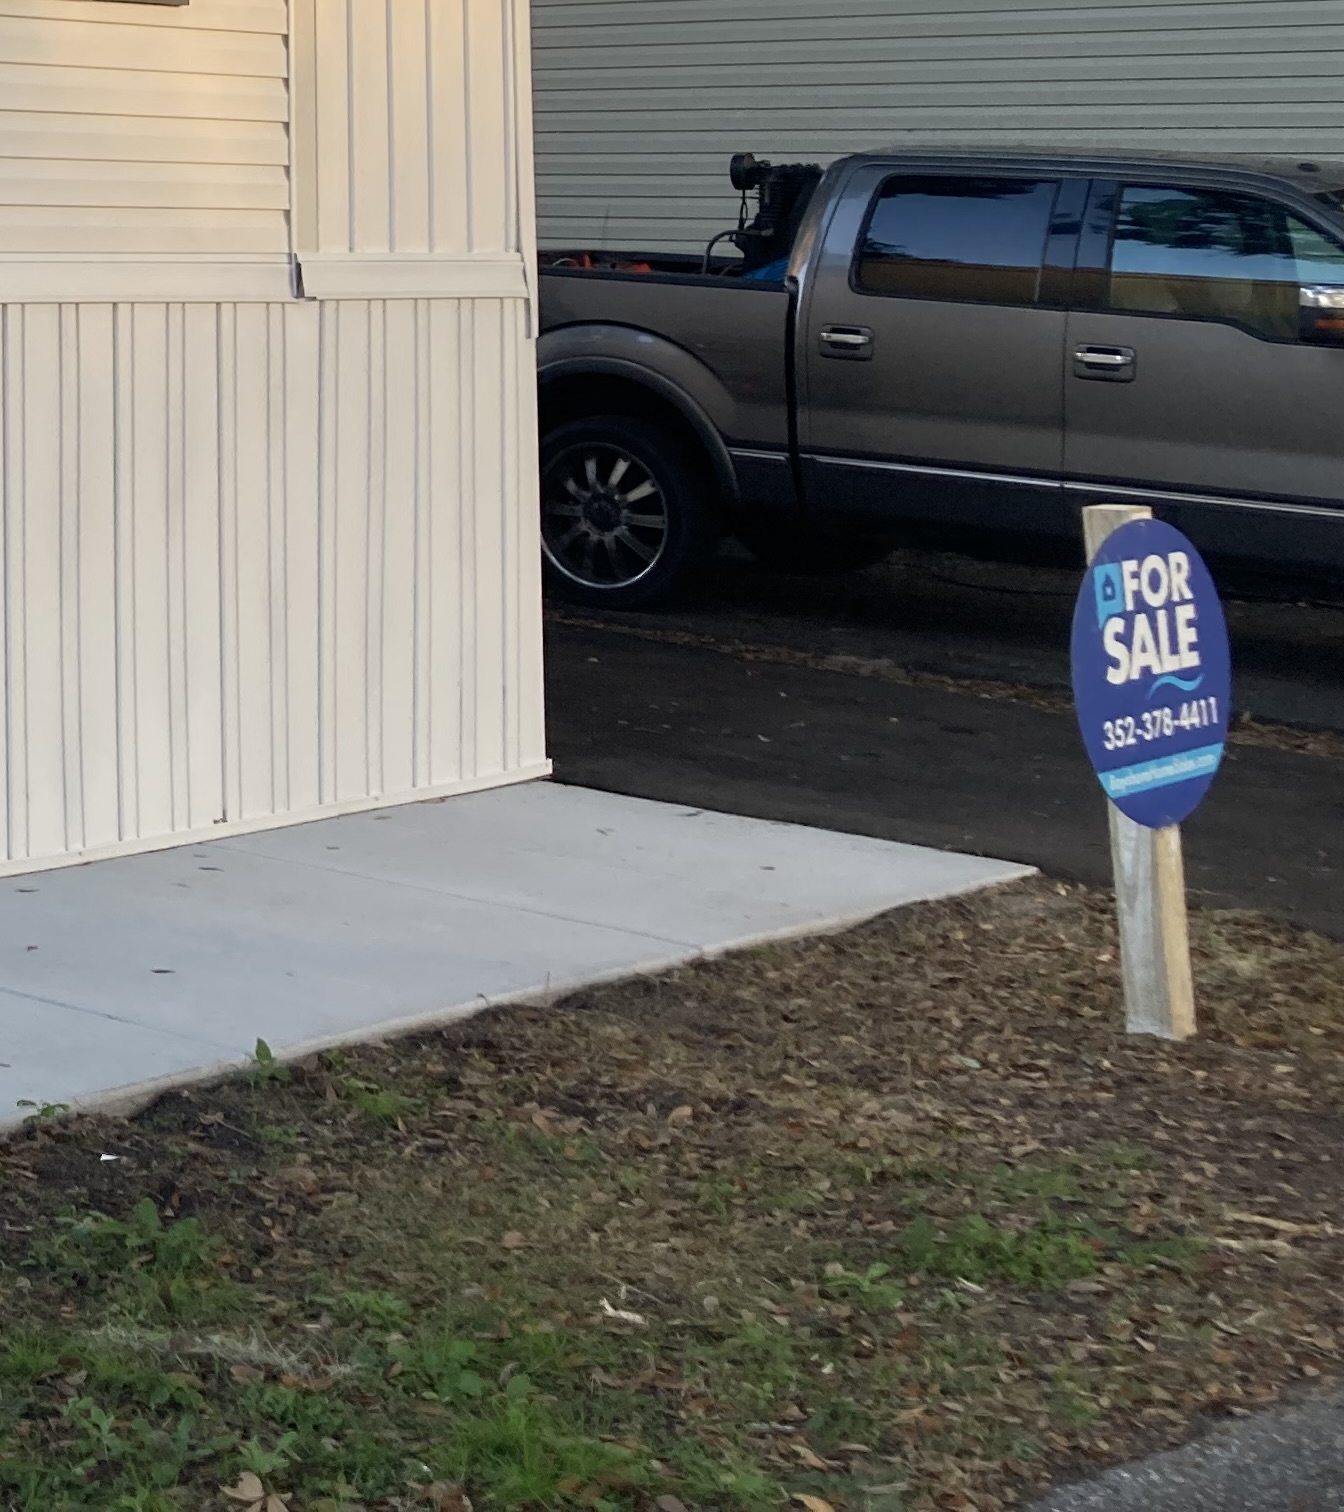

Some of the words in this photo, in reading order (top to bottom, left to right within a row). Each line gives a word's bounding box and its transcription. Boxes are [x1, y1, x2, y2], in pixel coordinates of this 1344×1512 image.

[1121, 551, 1194, 611] FOR
[1103, 604, 1201, 686] SALE
[1103, 696, 1218, 751] 352-378-4411
